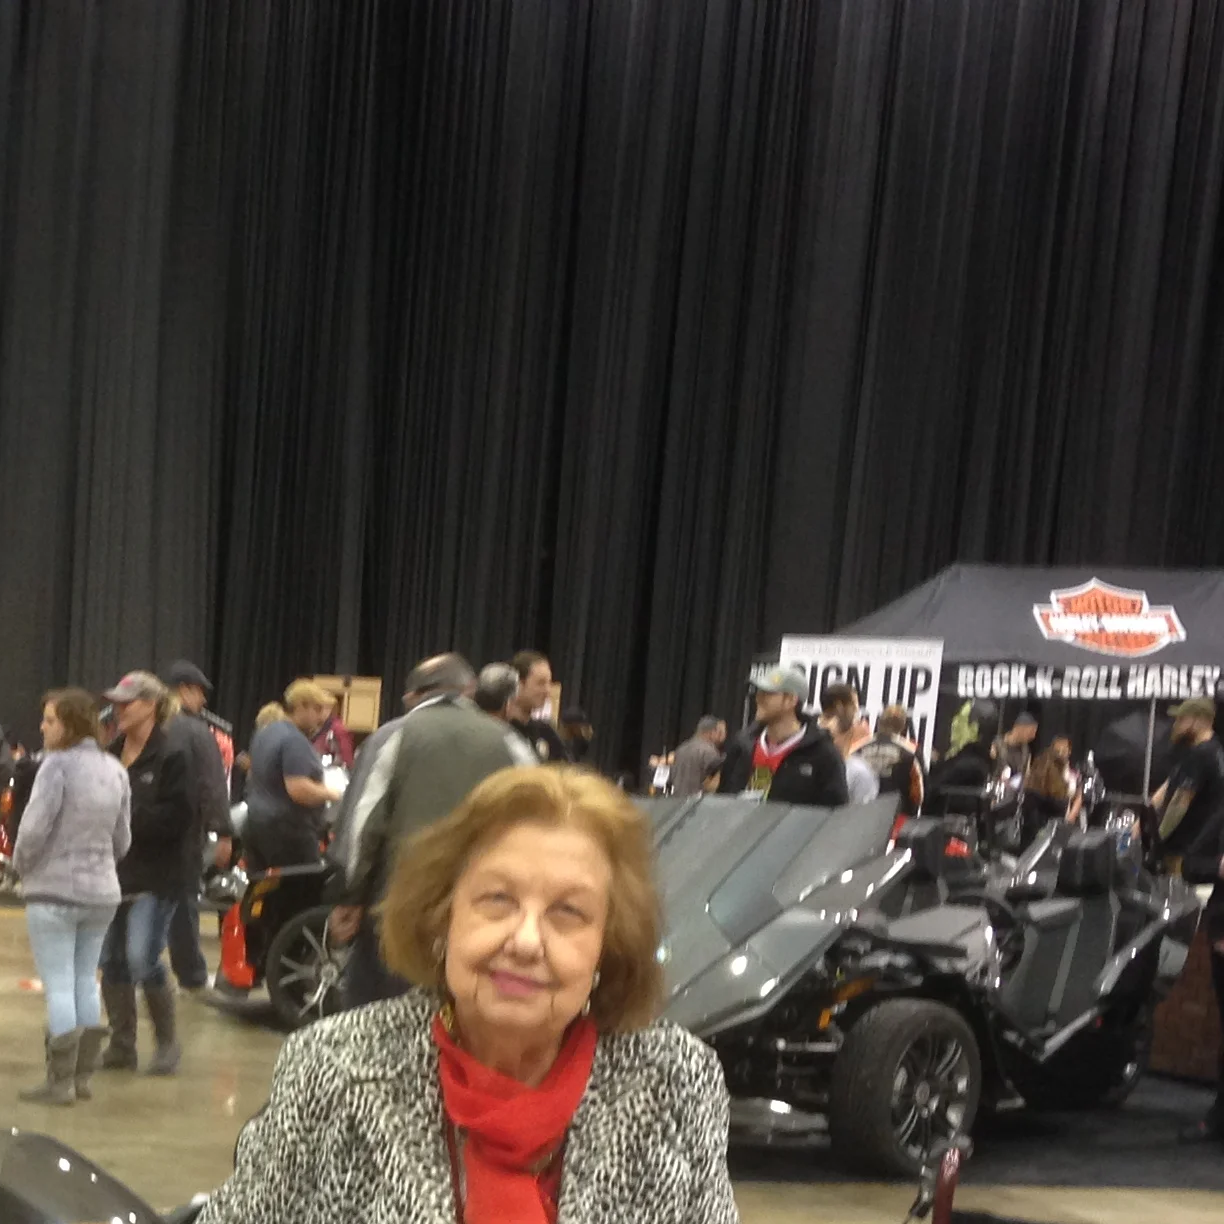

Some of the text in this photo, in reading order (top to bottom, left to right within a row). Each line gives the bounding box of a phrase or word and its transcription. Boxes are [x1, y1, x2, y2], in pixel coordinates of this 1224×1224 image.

[785, 660, 933, 709] IGN UP
[957, 662, 1123, 699] ROCK-N-ROLL
